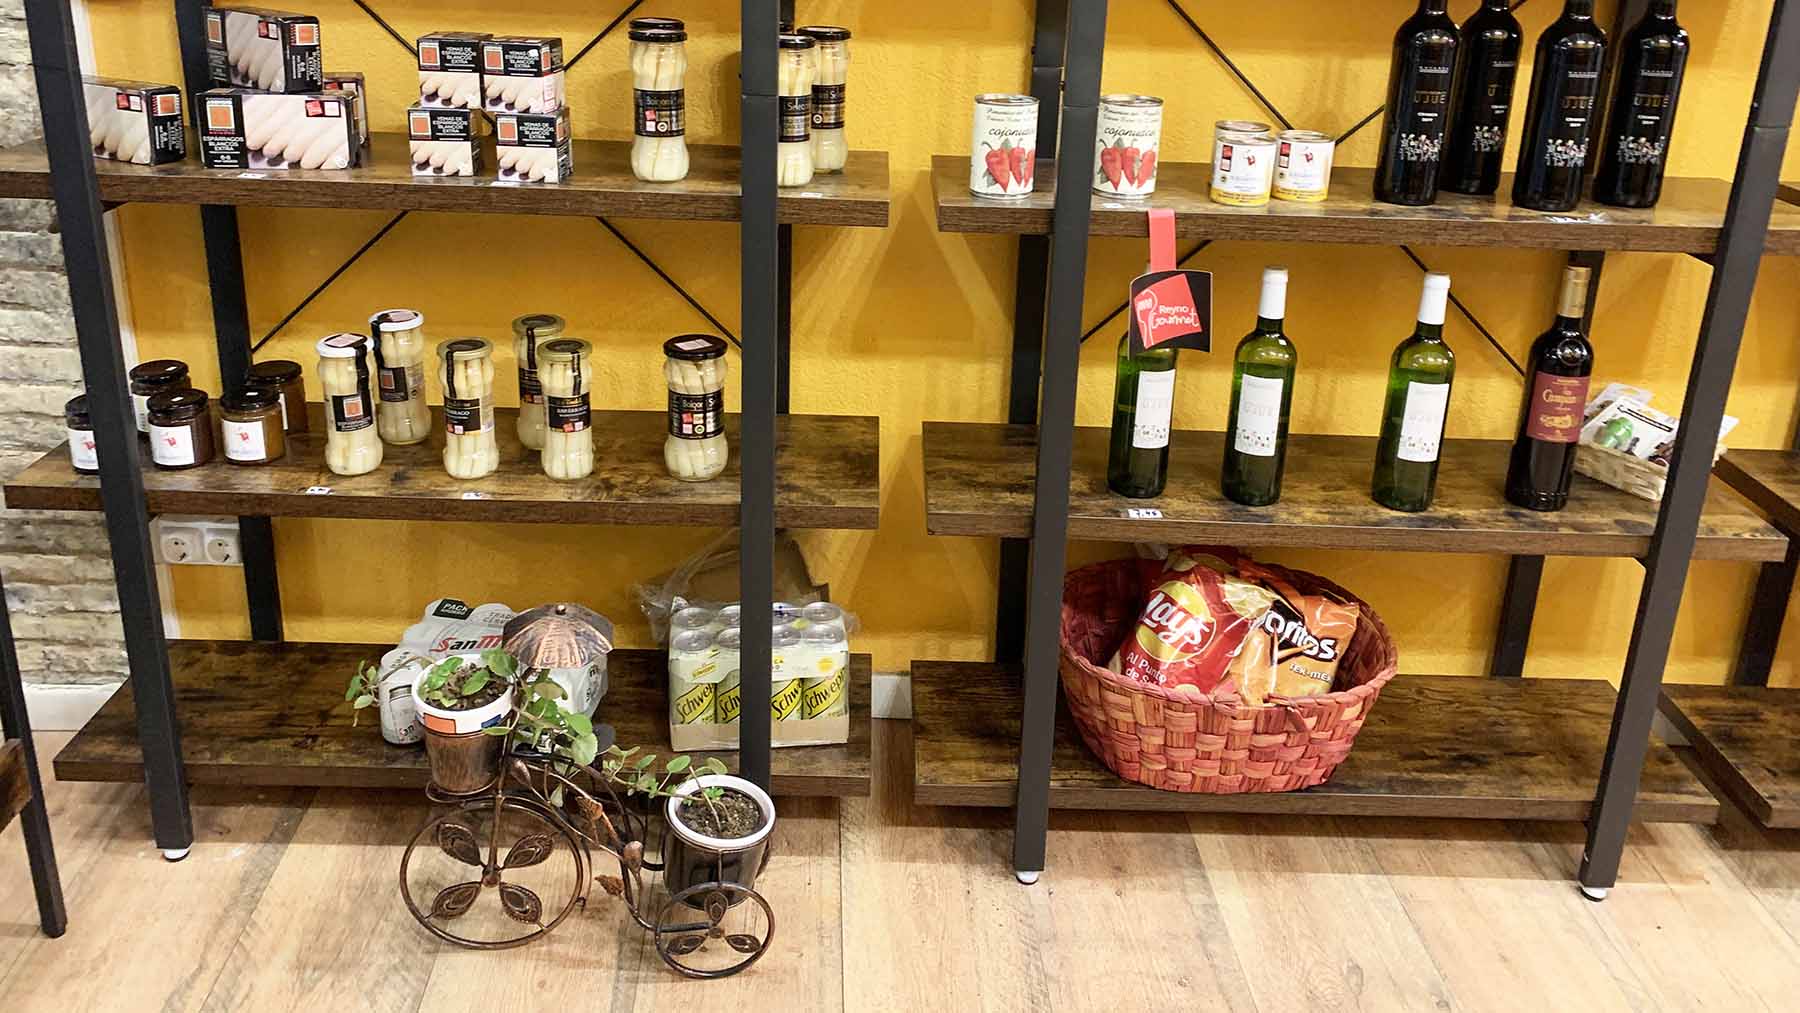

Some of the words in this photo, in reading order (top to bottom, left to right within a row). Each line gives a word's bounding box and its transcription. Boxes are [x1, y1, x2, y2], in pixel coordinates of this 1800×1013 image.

[1151, 307, 1200, 330] Gourmet
[1159, 304, 1189, 317] Reyno
[1125, 667, 1140, 680] de
[1126, 651, 1139, 665] Al
[1138, 659, 1167, 684] Punto
